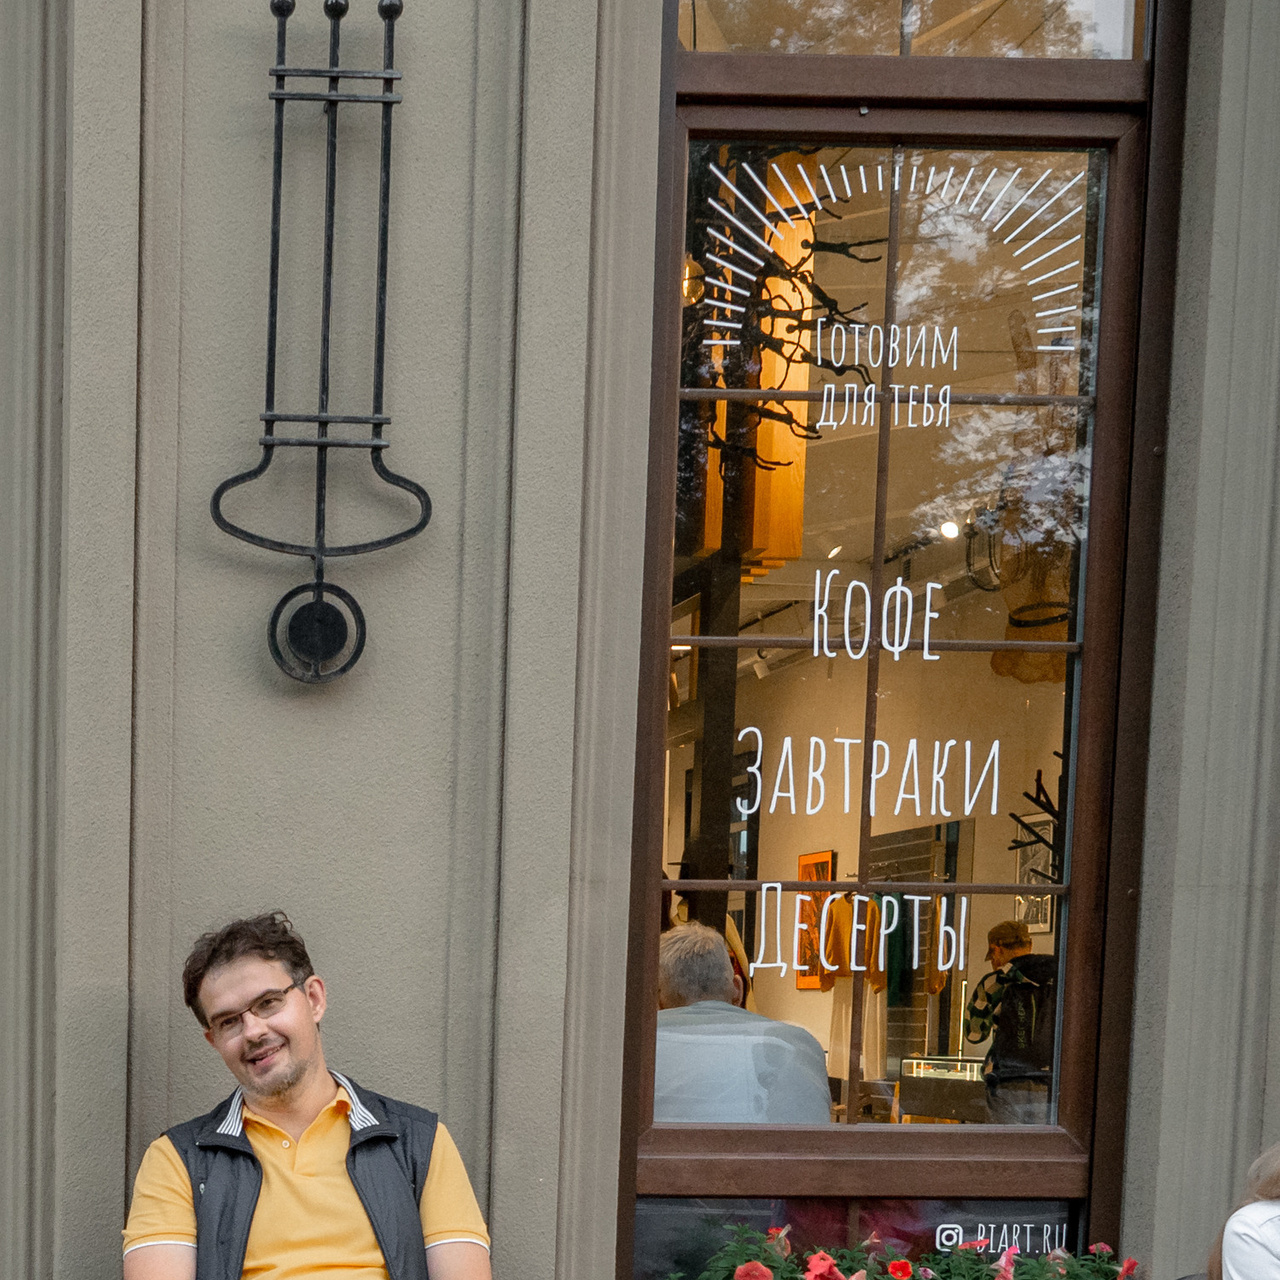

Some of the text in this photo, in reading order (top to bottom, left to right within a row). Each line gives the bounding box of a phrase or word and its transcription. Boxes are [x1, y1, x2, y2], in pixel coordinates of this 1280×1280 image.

[816, 317, 958, 371] ГОТОВИМ
[815, 383, 951, 430] ДЛЯ ТЕБЯ
[813, 569, 942, 661] КОФЕ
[736, 726, 1000, 817] ЗАВТРАКИ
[749, 882, 967, 978] ДЕСЕРТЫ
[976, 1223, 1067, 1254] BIART.RU
